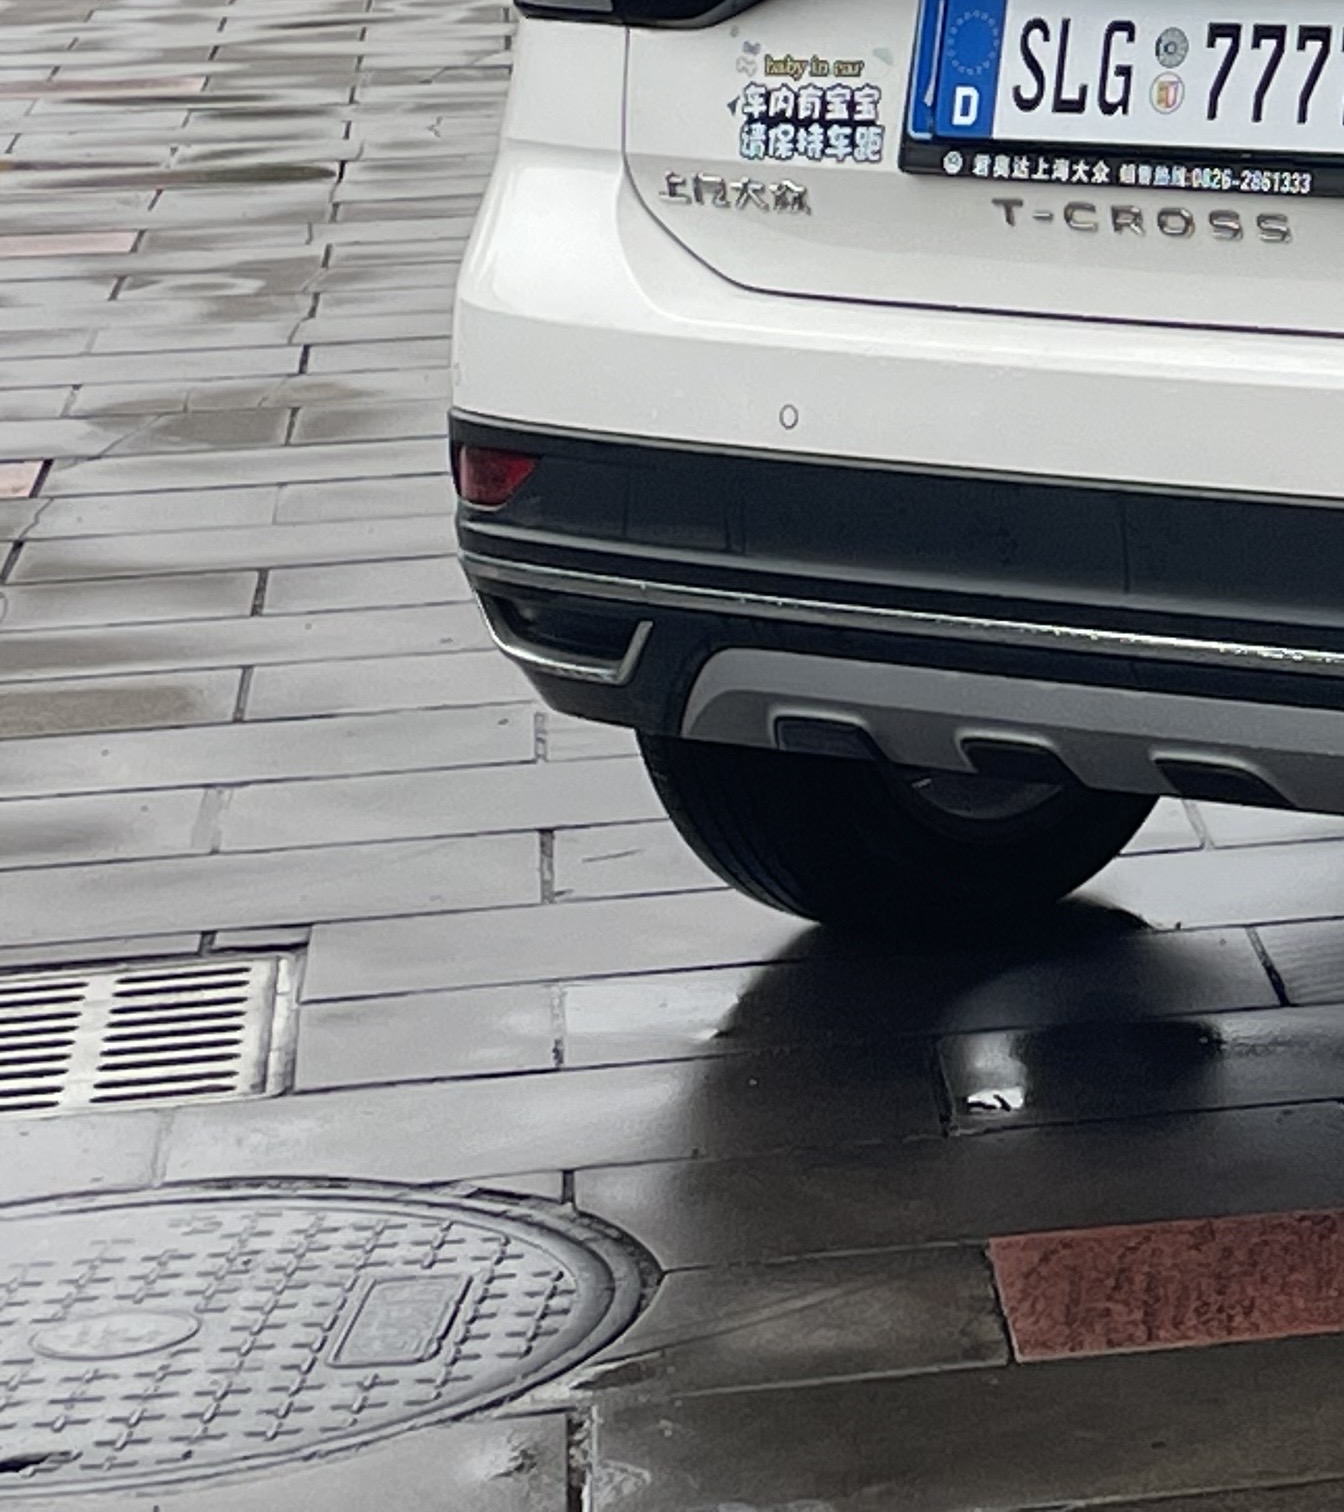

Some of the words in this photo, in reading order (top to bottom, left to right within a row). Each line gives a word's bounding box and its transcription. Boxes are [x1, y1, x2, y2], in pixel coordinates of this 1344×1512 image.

[764, 54, 810, 81] baby
[810, 55, 830, 77] in
[833, 59, 866, 78] car
[1012, 17, 1137, 116] SLG
[741, 81, 882, 122] 车内有宝宝
[951, 85, 980, 127] D
[991, 196, 1294, 244] T-CROSS
